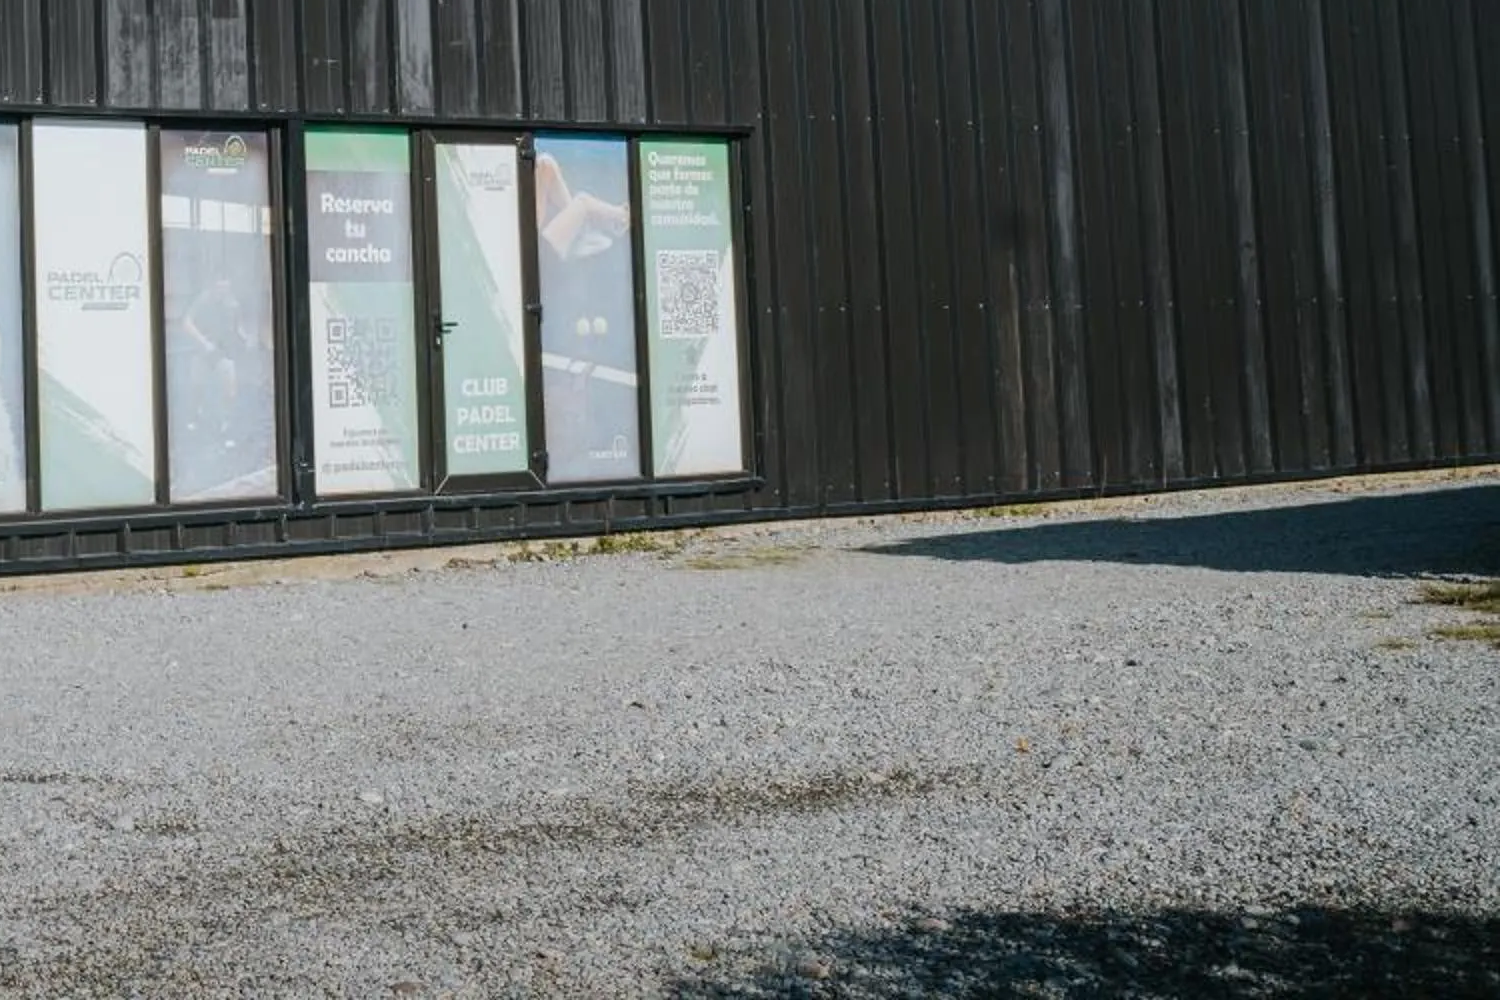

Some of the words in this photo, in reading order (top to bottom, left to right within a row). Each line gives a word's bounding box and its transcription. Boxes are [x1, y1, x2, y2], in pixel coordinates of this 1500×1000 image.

[321, 193, 393, 214] Reserva
[345, 219, 366, 238] tu
[325, 243, 392, 263] cancha
[47, 271, 103, 283] PADEL
[48, 285, 140, 300] CENTER
[461, 377, 508, 396] CLUB
[457, 405, 516, 426] PADEL
[453, 431, 519, 453] CENTER
